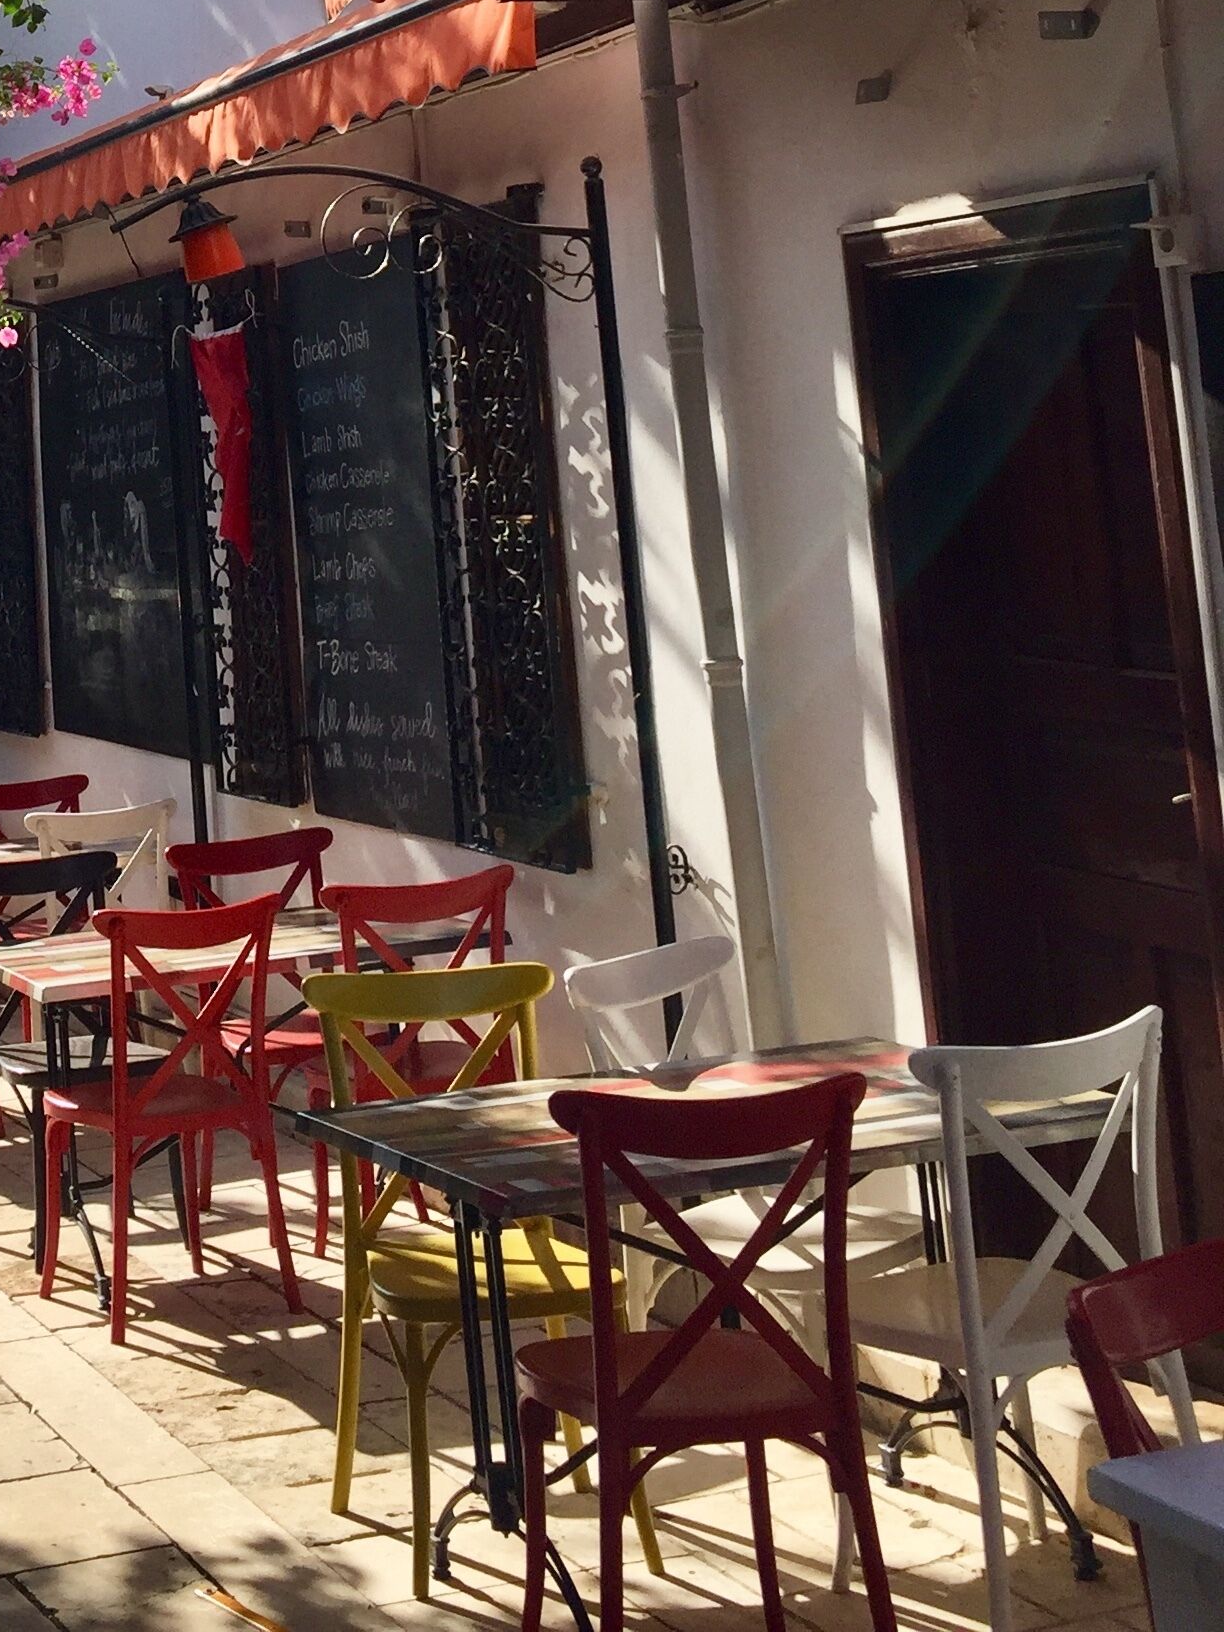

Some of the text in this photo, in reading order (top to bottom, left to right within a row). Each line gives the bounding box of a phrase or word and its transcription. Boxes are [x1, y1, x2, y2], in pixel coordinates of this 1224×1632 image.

[293, 320, 369, 368] Chicken Shish
[301, 424, 363, 458] Lamb Shish
[312, 552, 342, 581] Lamb
[316, 639, 398, 676] T-Bone Steak
[317, 692, 341, 742] All
